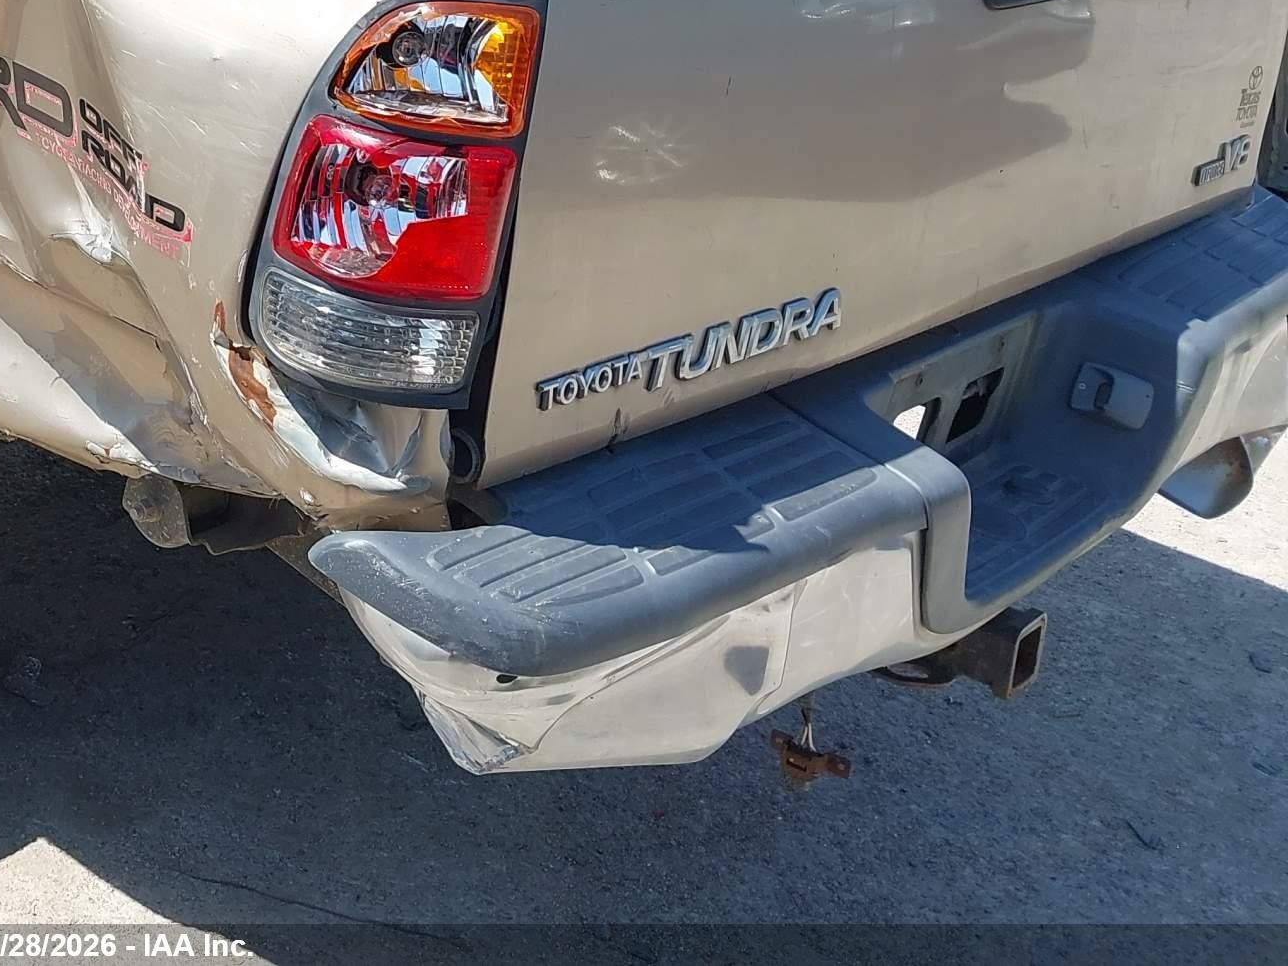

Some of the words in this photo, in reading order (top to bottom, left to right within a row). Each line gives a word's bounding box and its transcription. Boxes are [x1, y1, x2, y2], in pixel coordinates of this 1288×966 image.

[79, 98, 144, 168] OFF
[1217, 134, 1252, 172] V8
[535, 350, 644, 411] TOYOTA
[643, 286, 842, 393] TUNDRA
